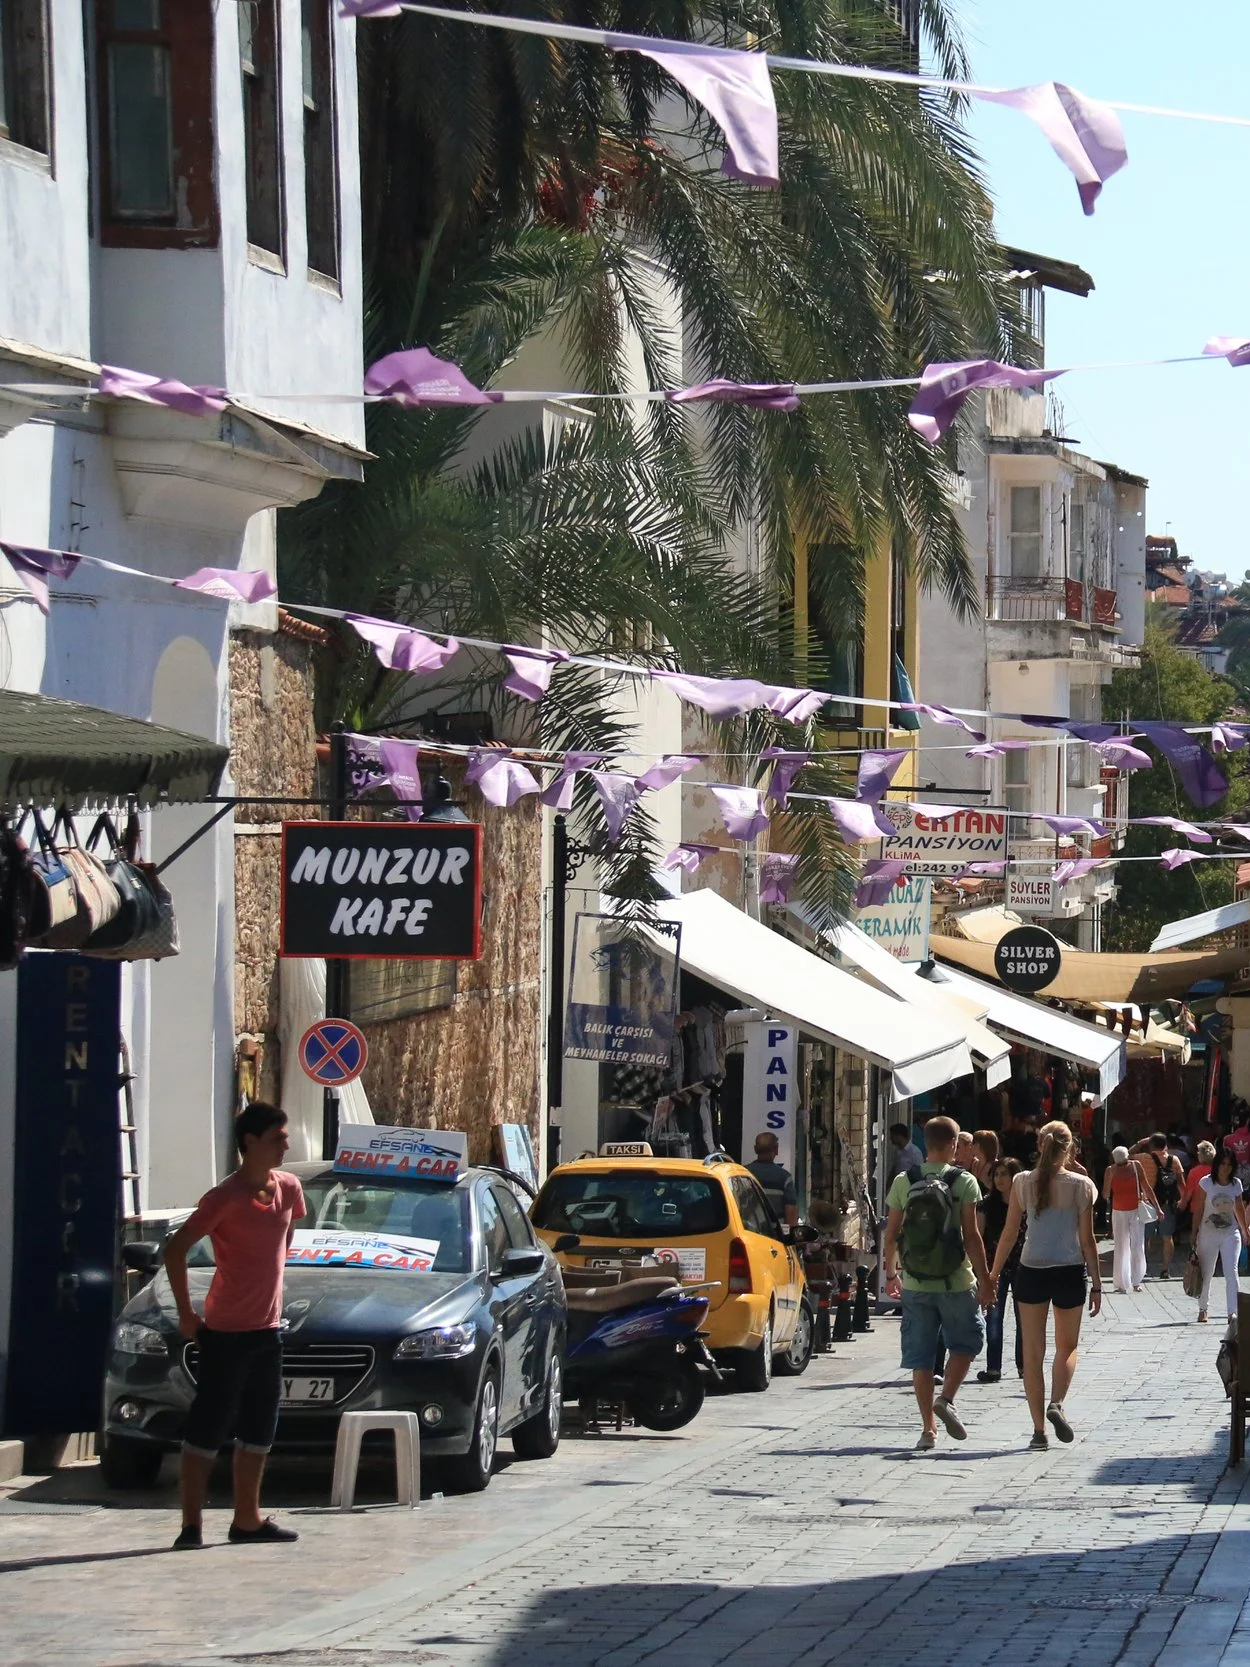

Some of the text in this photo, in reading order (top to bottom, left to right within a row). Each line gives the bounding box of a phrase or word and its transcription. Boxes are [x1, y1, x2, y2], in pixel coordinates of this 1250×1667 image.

[886, 835, 1002, 851] PANSİYON
[290, 846, 470, 885] MUNZUR
[902, 863, 946, 873] el:242
[1010, 895, 1050, 905] PANSİYON
[329, 897, 433, 936] KAFE
[1000, 946, 1055, 959] SILVER
[1006, 962, 1049, 974] SHOP
[584, 1022, 654, 1038] BALIK ÇARŞISI
[611, 1038, 625, 1048] VE
[564, 1047, 668, 1065] MEYHANELER SOKAĞI
[337, 1150, 459, 1177] RENT A CAR
[285, 1248, 431, 1272] ENT A CAR
[309, 1380, 331, 1398] 27
